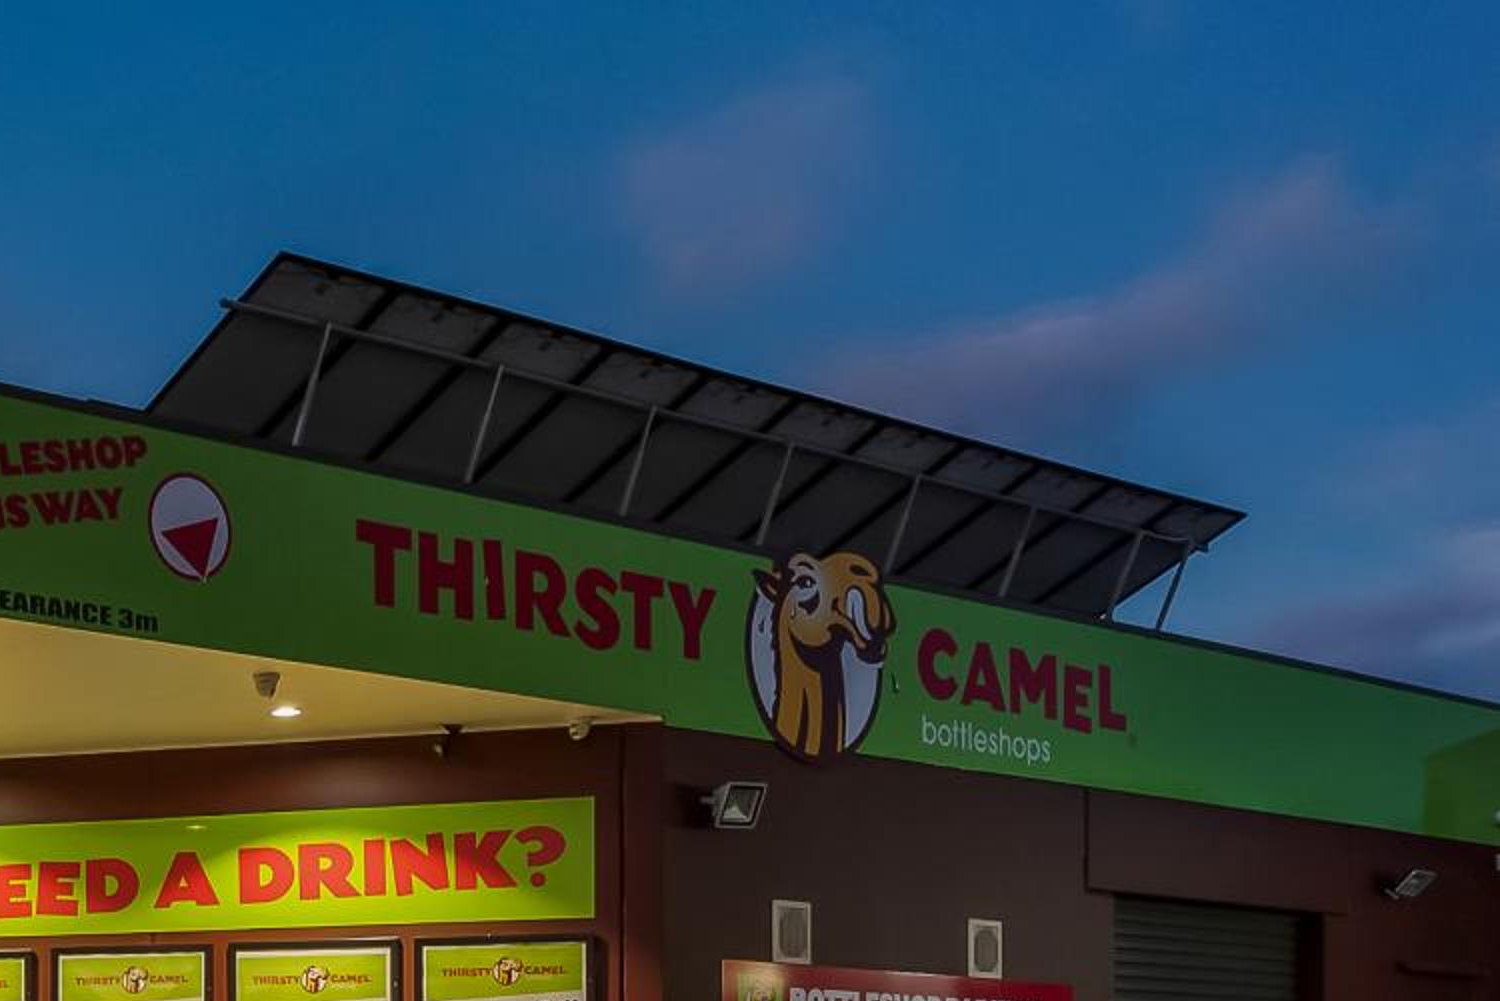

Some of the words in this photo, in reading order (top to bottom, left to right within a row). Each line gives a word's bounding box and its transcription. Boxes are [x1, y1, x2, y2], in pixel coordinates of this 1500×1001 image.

[35, 487, 123, 526] WAY
[118, 608, 159, 633] 3m
[355, 518, 717, 660] THIRSTY
[917, 627, 1127, 734] CAMEL
[921, 715, 1051, 766] bottleshops
[153, 851, 220, 908] A
[237, 825, 566, 905] DRINK?
[442, 968, 492, 977] THIRSTY
[525, 965, 565, 975] CAMEL
